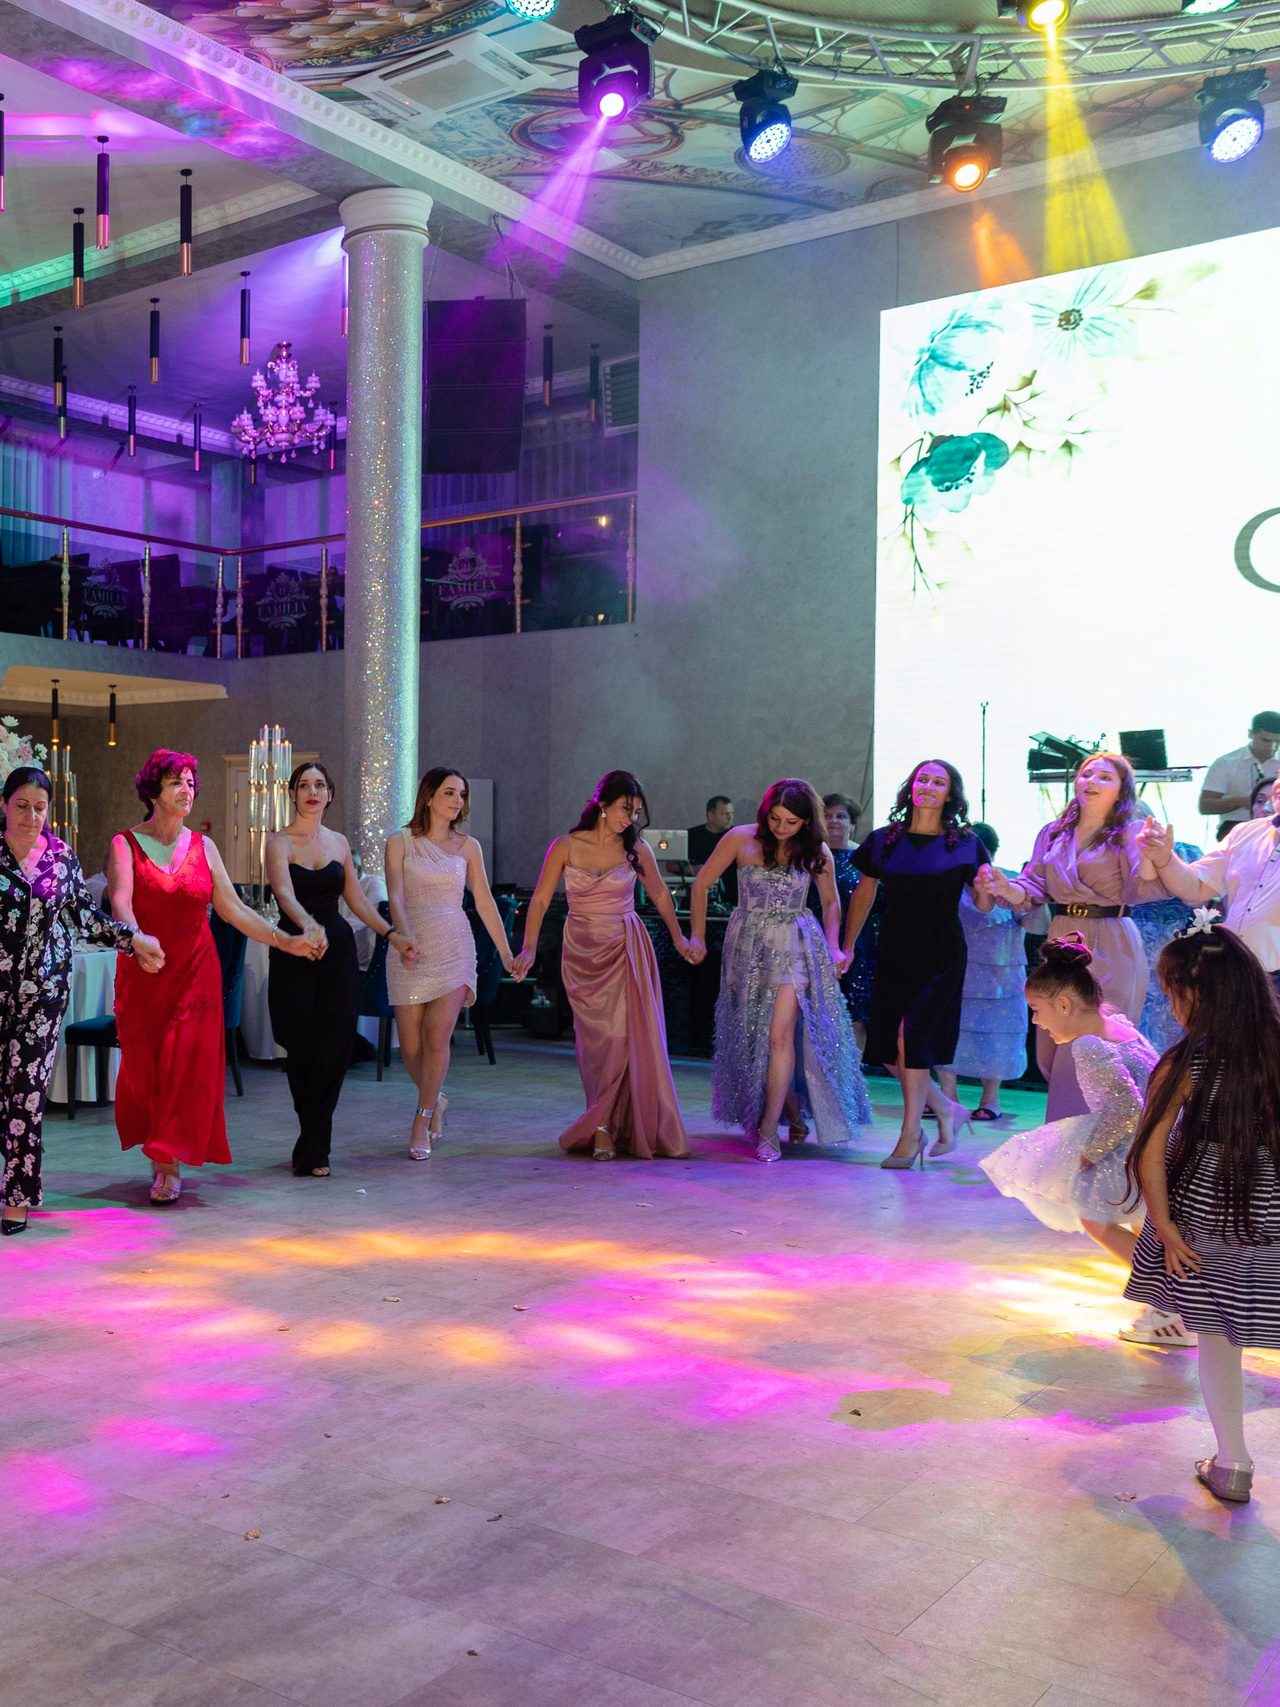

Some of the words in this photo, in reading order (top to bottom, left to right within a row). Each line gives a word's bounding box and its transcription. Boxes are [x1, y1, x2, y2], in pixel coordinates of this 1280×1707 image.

[83, 587, 127, 605] FAMILIA
[439, 579, 496, 596] FAMILIA
[258, 601, 307, 617] FAMILIA
